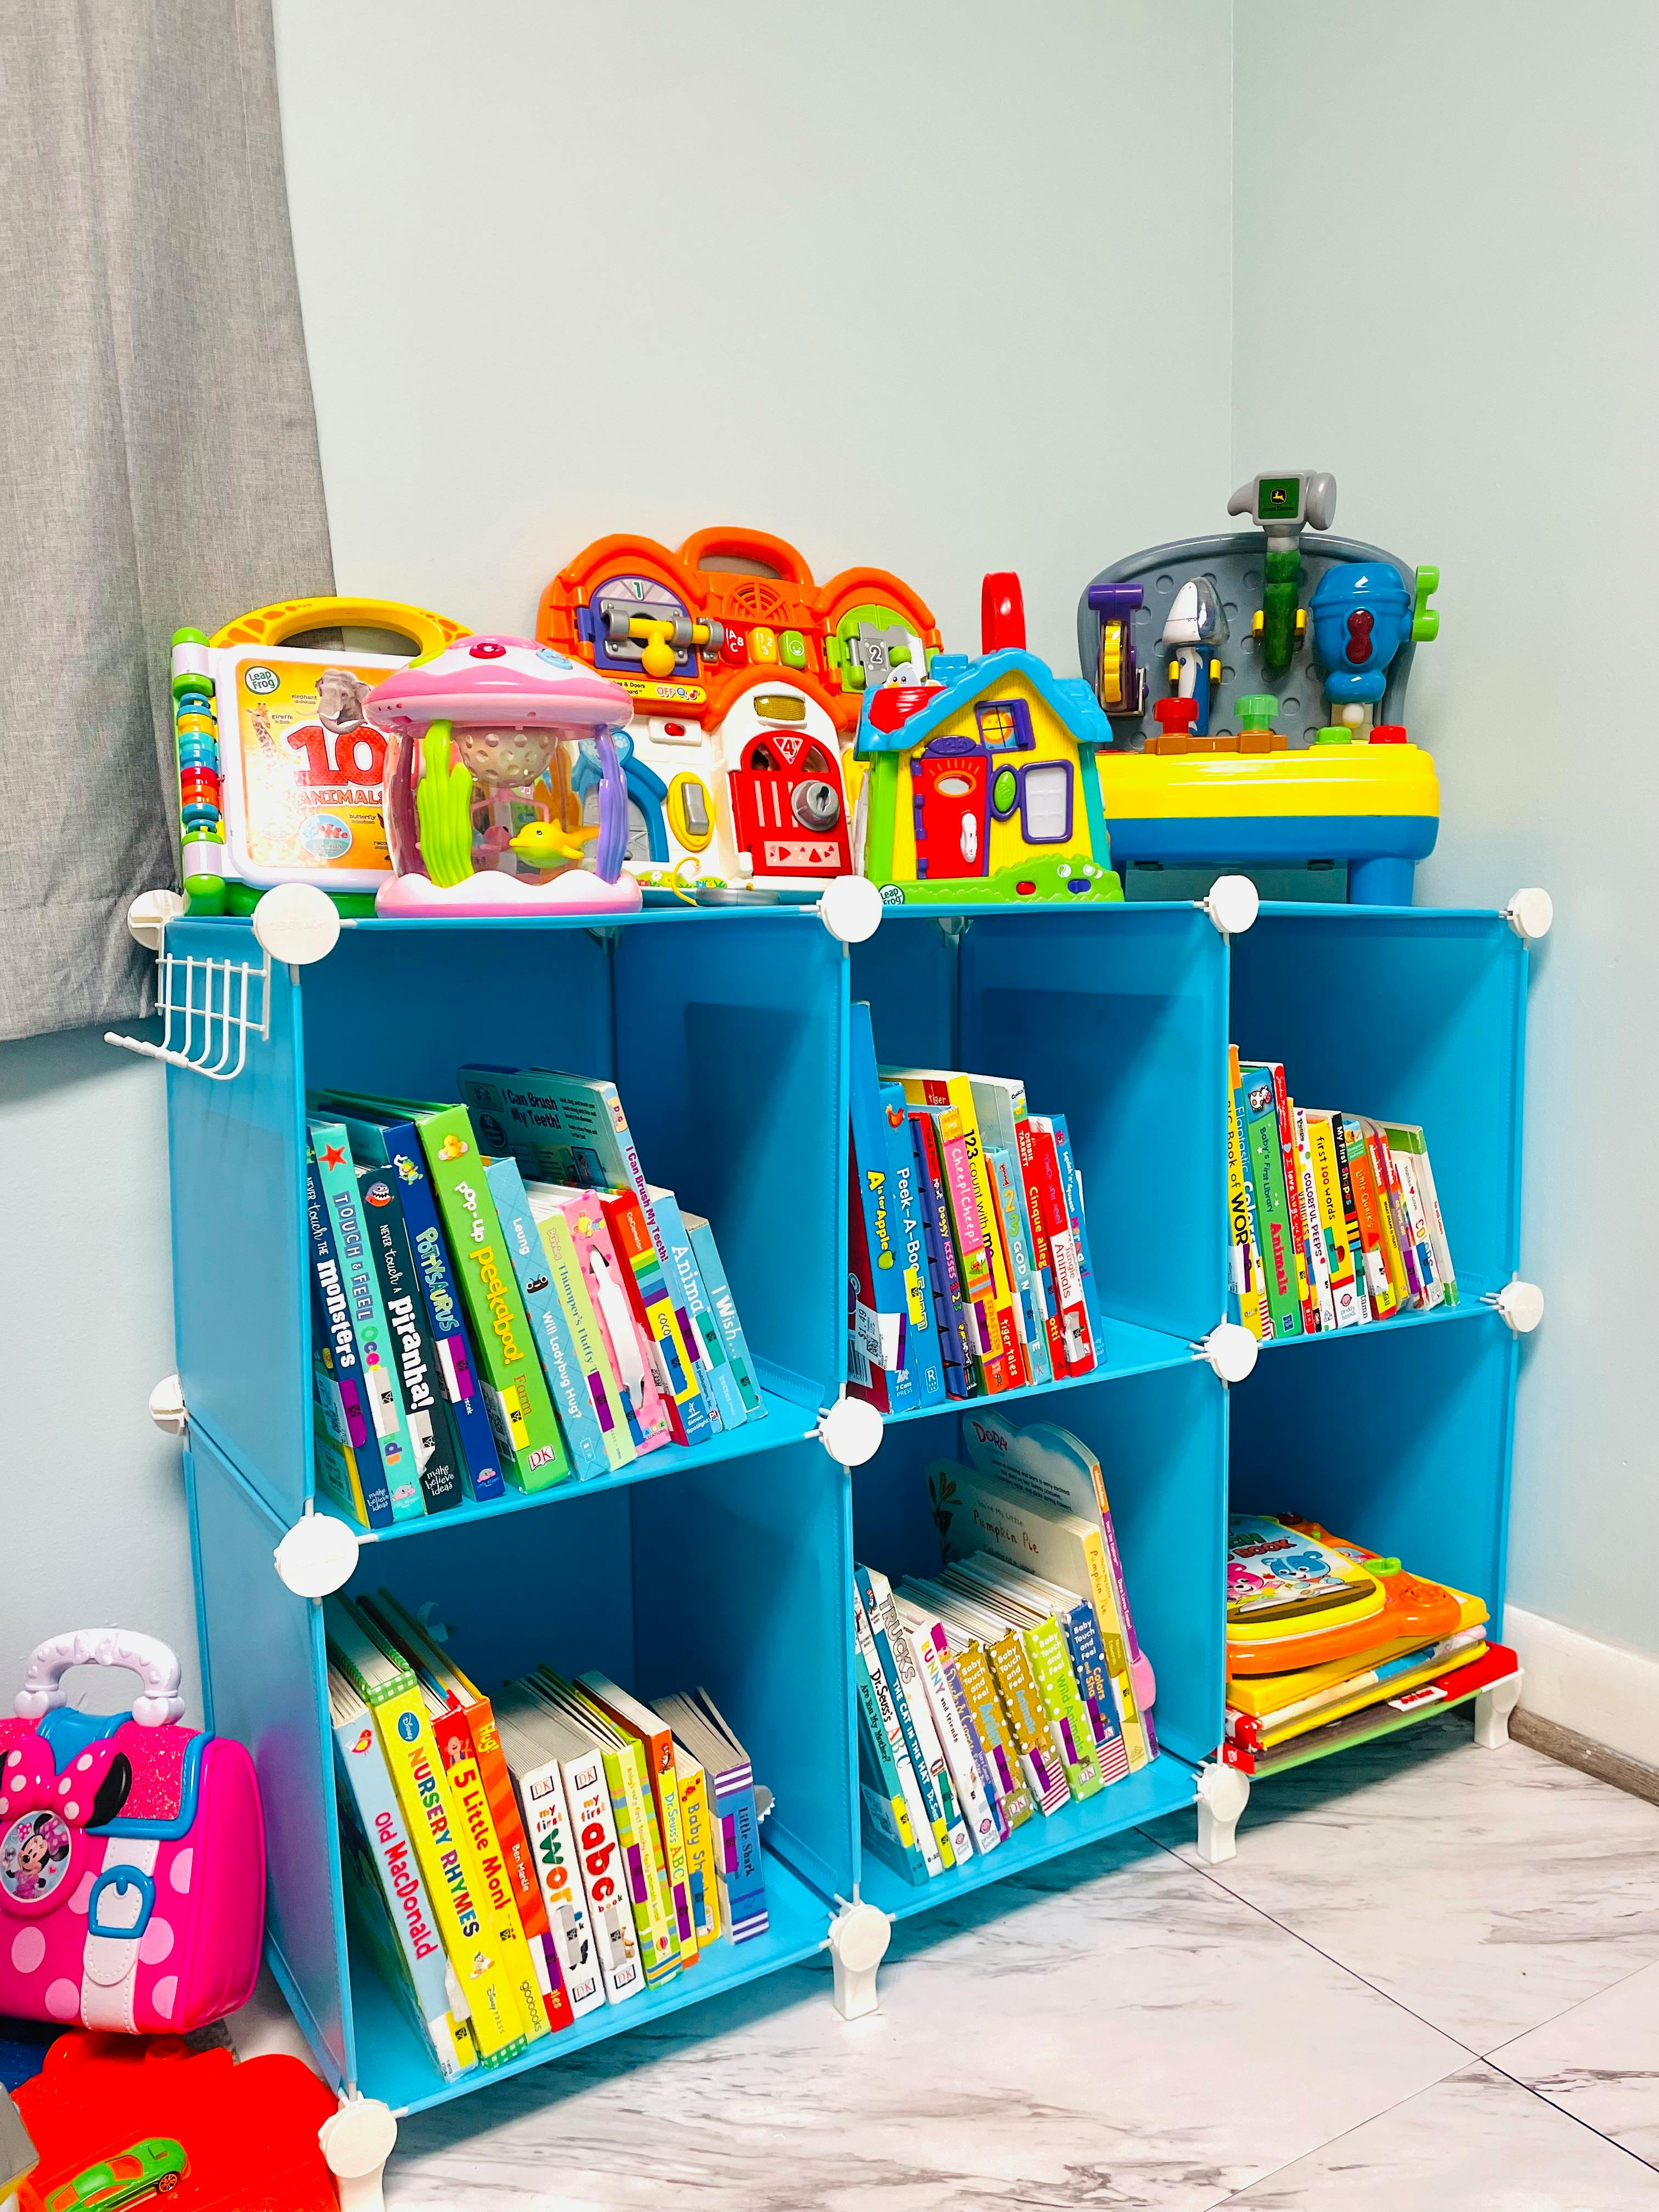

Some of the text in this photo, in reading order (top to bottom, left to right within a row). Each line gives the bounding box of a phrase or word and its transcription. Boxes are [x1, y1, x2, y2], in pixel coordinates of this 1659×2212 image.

[870, 646, 882, 664] 2
[249, 670, 272, 684] Leap
[252, 678, 275, 690] Frog
[291, 693, 318, 702] elephant
[656, 687, 675, 697] OFF
[287, 725, 388, 786] 10
[783, 740, 795, 758] 4
[880, 888, 899, 900] Leap
[506, 1090, 527, 1107] Can
[527, 1091, 558, 1111] Brush
[928, 1093, 946, 1105] tiger
[511, 1107, 527, 1127] My
[527, 1109, 561, 1130] Teeth!
[1296, 1117, 1305, 1142] Peeps
[1018, 1130, 1028, 1167] TARBETT
[1024, 1132, 1034, 1162] DEBBIE
[1260, 1126, 1274, 1213] Baby's First Library
[1317, 1136, 1336, 1221] first 100 words
[1336, 1126, 1352, 1206] My First Shapes
[306, 1176, 317, 1201] NEVER
[1231, 1173, 1241, 1188] of
[1285, 1157, 1293, 1167] I
[1290, 1192, 1299, 1220] hugs
[628, 1153, 669, 1262] Can Brush My Teeth!
[951, 1147, 969, 1194] Cheep!
[960, 1195, 980, 1245] Cheep!
[969, 1163, 990, 1230] count with
[308, 1201, 328, 1241] touch
[1029, 1186, 1042, 1234] Cinque
[1298, 1190, 1310, 1235] VEHICLES
[1304, 1172, 1323, 1257] COLORFUL PEEPS
[513, 1217, 531, 1256] Leung
[627, 1211, 642, 1252] CoComelon
[874, 1209, 891, 1251] Apple
[1005, 1188, 1026, 1276] 2 3 GOD
[317, 1241, 329, 1256] THE
[334, 1192, 373, 1321] TOUCH FEEL
[547, 1228, 562, 1261] Bunnies
[1065, 1247, 1075, 1279] Jungle
[1269, 1221, 1289, 1296] Animals
[453, 1181, 524, 1365] pop-up peekaboo!
[1054, 1244, 1071, 1299] Animals
[711, 1284, 727, 1295] I
[952, 1292, 963, 1312] 2 3
[317, 1258, 356, 1369] monsters
[380, 1224, 435, 1410] NEVER touch piranha!
[558, 1262, 594, 1364] Thumper's Fluffy
[857, 1308, 867, 1340] $1.49
[986, 1299, 1001, 1350] SEBASTIEN
[1000, 1318, 1018, 1376] tiger tales
[542, 1310, 583, 1419] Will Ladybug Hug?
[514, 1373, 532, 1416] Farm
[896, 1388, 913, 1397] PRESS
[899, 1382, 912, 1390] Cats
[686, 1419, 710, 1435] Spotlight
[529, 1447, 553, 1469] DK
[425, 1474, 455, 1491] believe
[427, 1465, 450, 1479] make
[366, 1495, 390, 1508] believe
[368, 1488, 386, 1500] make
[432, 1482, 454, 1497] ideas
[371, 1501, 388, 1513] ideas
[973, 1509, 1039, 1554] Pumpkin Pie
[1231, 1539, 1298, 1559] BOOK
[1090, 1549, 1103, 1595] Pumpkin
[879, 1593, 916, 1684] TRUCKS
[1073, 1620, 1092, 1634] Baby
[1074, 1628, 1096, 1644] Touch
[1039, 1632, 1058, 1649] Baby
[1039, 1640, 1062, 1658] Touch
[1079, 1638, 1094, 1651] and
[997, 1646, 1017, 1663] Baby
[998, 1653, 1021, 1673] Touch
[1047, 1651, 1061, 1666] and
[1081, 1647, 1097, 1661] Feel
[961, 1658, 981, 1676] Baby
[963, 1667, 986, 1686] Touch
[1007, 1667, 1022, 1681] and
[1048, 1661, 1064, 1676] Feel
[1084, 1661, 1092, 1676] and
[921, 1640, 959, 1743] BUNNY and friends
[970, 1678, 985, 1692] and
[972, 1686, 989, 1703] Feel
[1008, 1674, 1025, 1690] Feel
[1092, 1666, 1105, 1701] Colors
[860, 1684, 891, 1764] Are You My Mother?
[870, 1668, 911, 1769] Dr. Seuss's ABC
[1056, 1673, 1084, 1753] Wild Animals
[893, 1678, 930, 1786] THE CAT IN THE HAT
[453, 1768, 489, 1851] 5 Little
[539, 1804, 557, 1818] my
[581, 1805, 607, 1823] first
[583, 1796, 600, 1812] my
[537, 1812, 563, 1833] first
[663, 1791, 679, 1844] Dr. Seuss's
[406, 1745, 481, 1939] NURSERY RHYMES
[512, 1843, 531, 1893] Ben Mantle
[582, 1821, 616, 1903] abc
[374, 1810, 439, 1961] Old MacDonald
[598, 1893, 624, 1913] book
[520, 1979, 543, 2033] igloobooks
